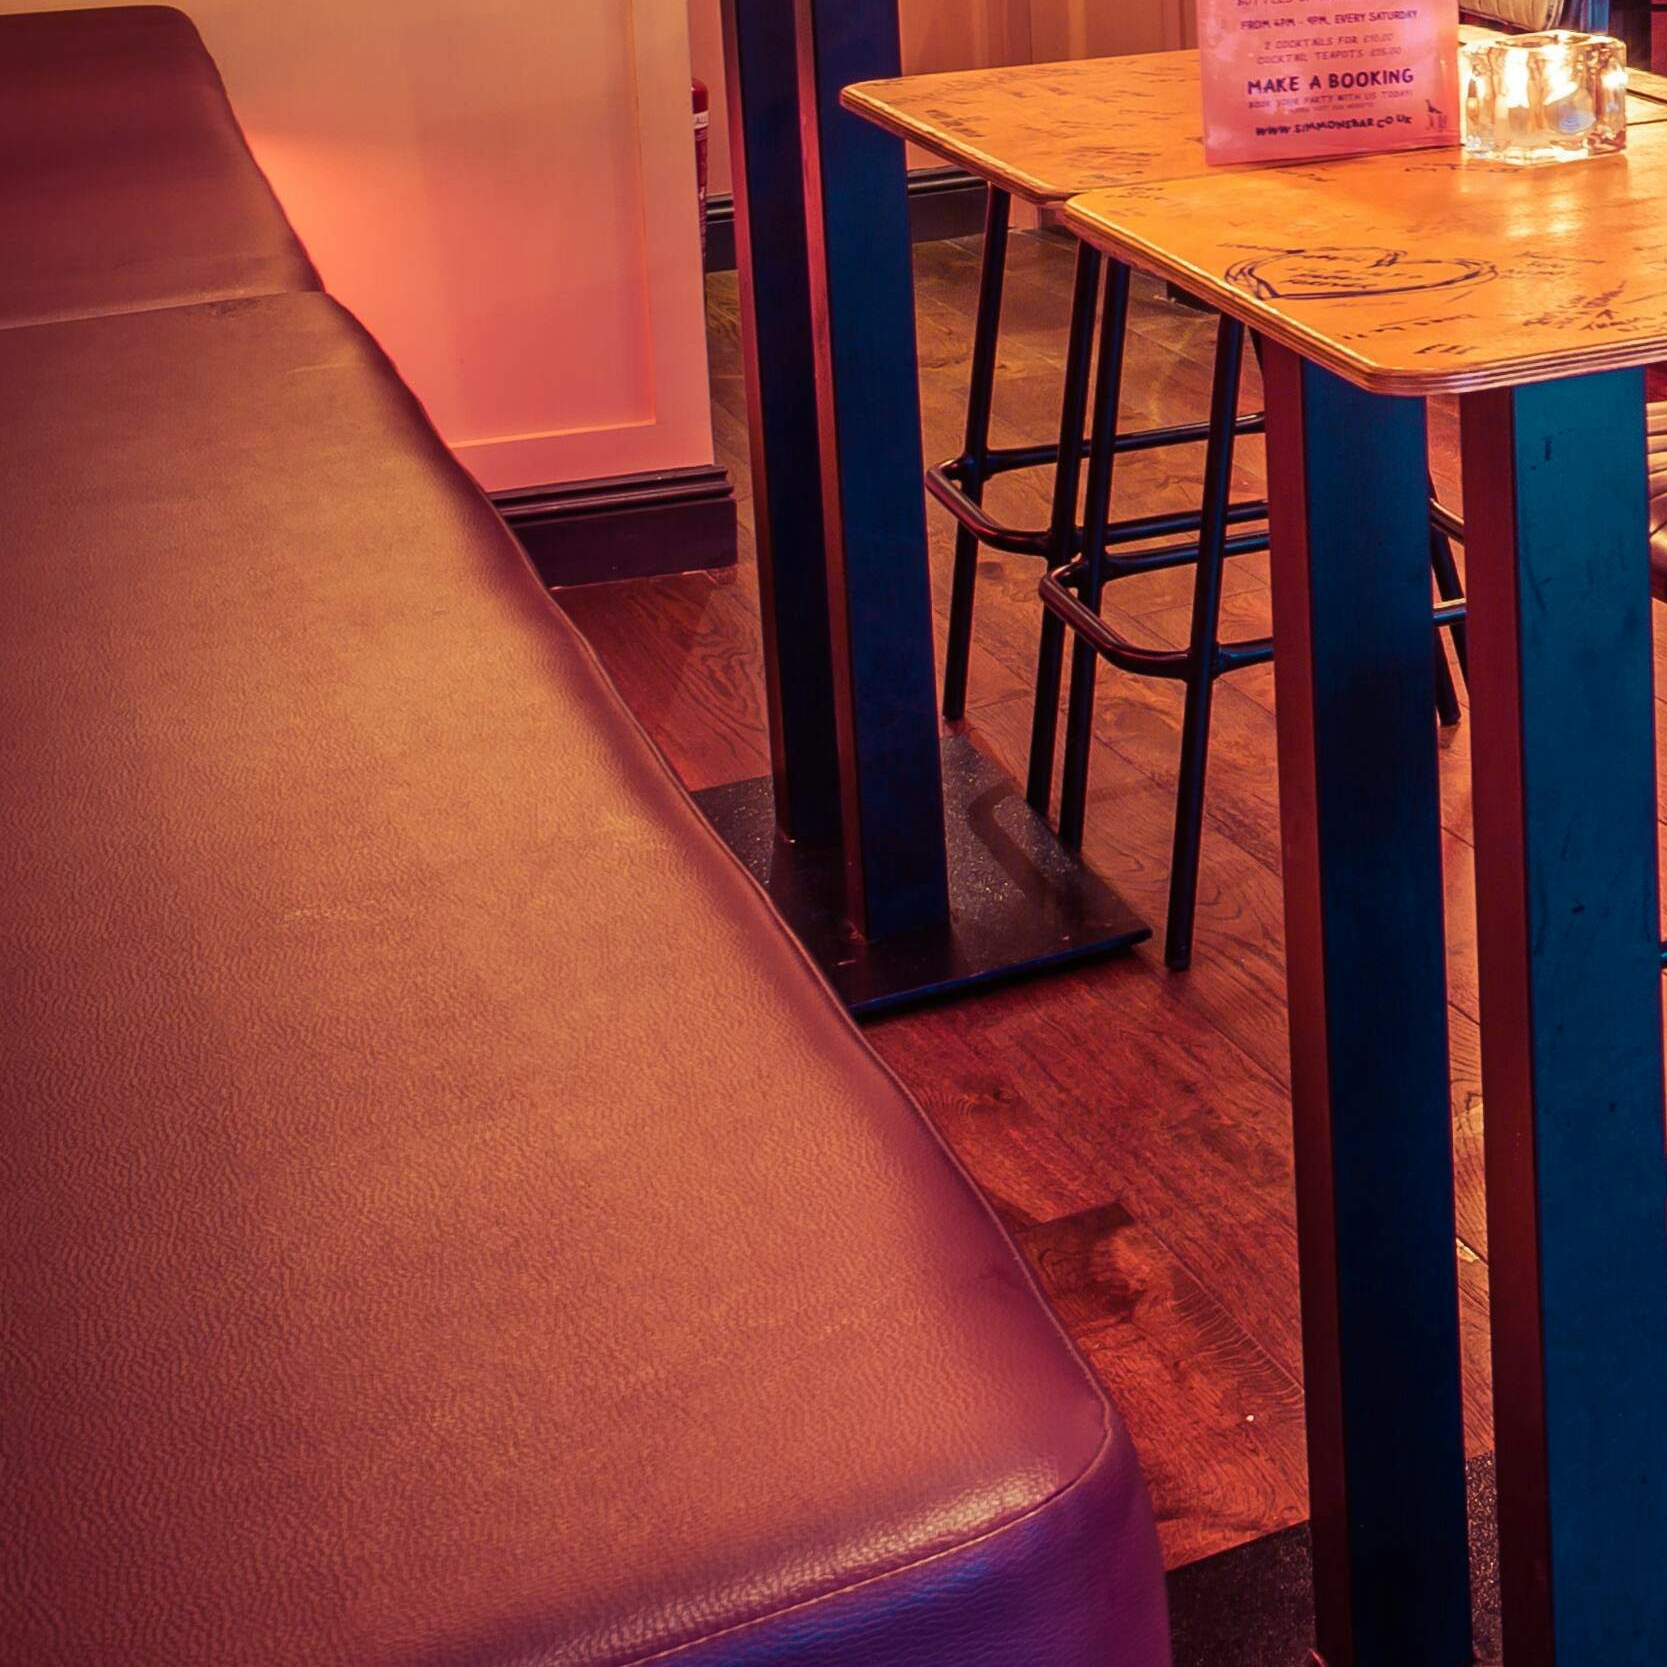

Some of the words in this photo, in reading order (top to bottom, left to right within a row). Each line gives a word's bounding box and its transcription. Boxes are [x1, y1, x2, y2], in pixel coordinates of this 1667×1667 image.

[1240, 20, 1271, 30] FROM
[1334, 13, 1366, 25] EVERY
[1369, 10, 1418, 23] SATURDAY
[1247, 76, 1300, 95] MAKE
[1309, 75, 1321, 90] A
[1327, 68, 1414, 90] BOOKING
